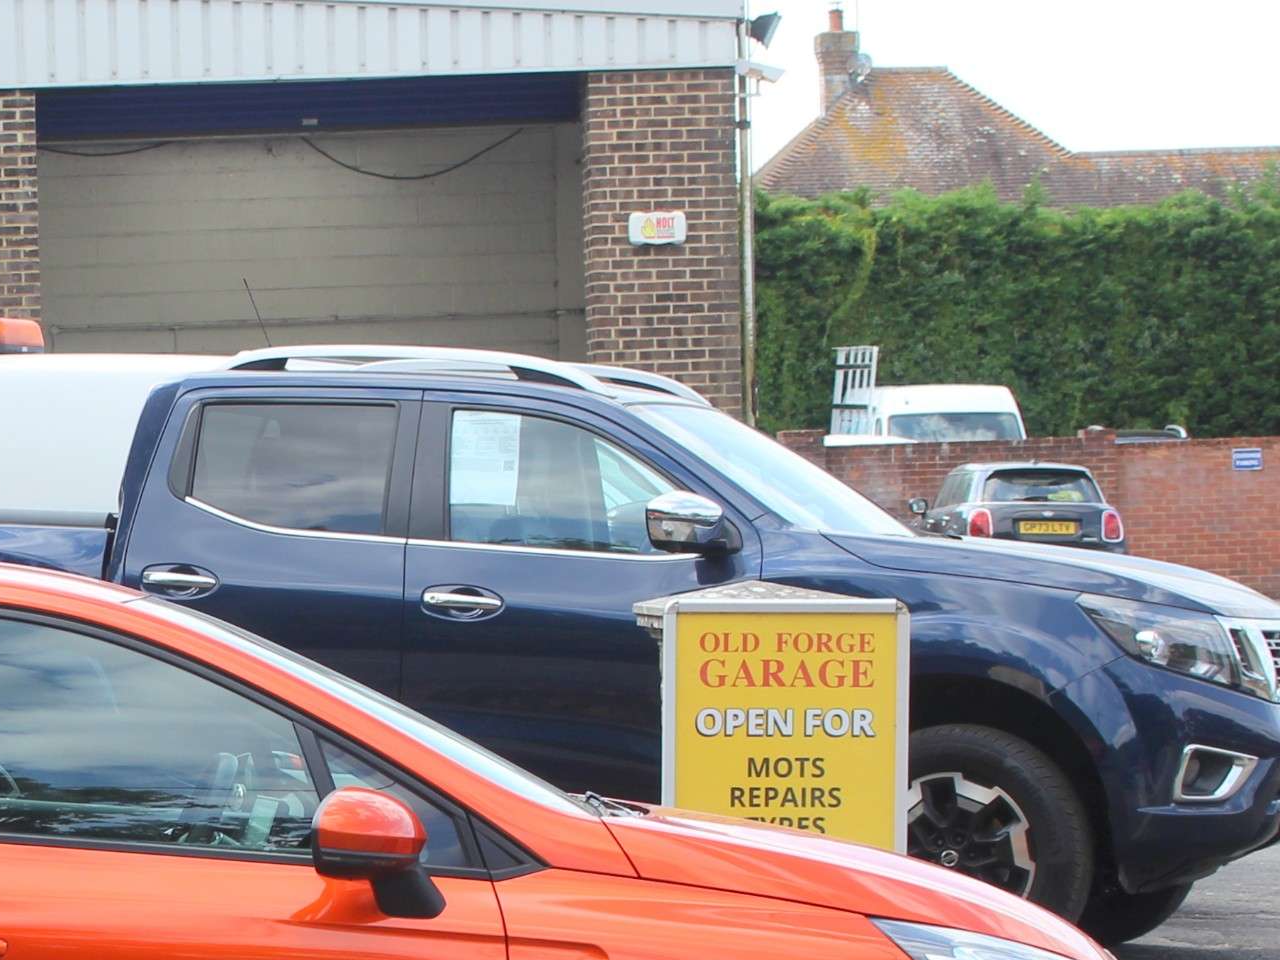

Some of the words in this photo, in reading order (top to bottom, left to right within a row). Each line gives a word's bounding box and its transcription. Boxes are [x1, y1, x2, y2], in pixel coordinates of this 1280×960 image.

[699, 632, 760, 653] OLD
[776, 632, 876, 653] FORGE
[699, 658, 876, 688] GARAGE
[695, 708, 794, 737] OPEN
[803, 708, 876, 738] FOR
[747, 757, 825, 778] MOTS
[730, 787, 842, 808] REPAIRS
